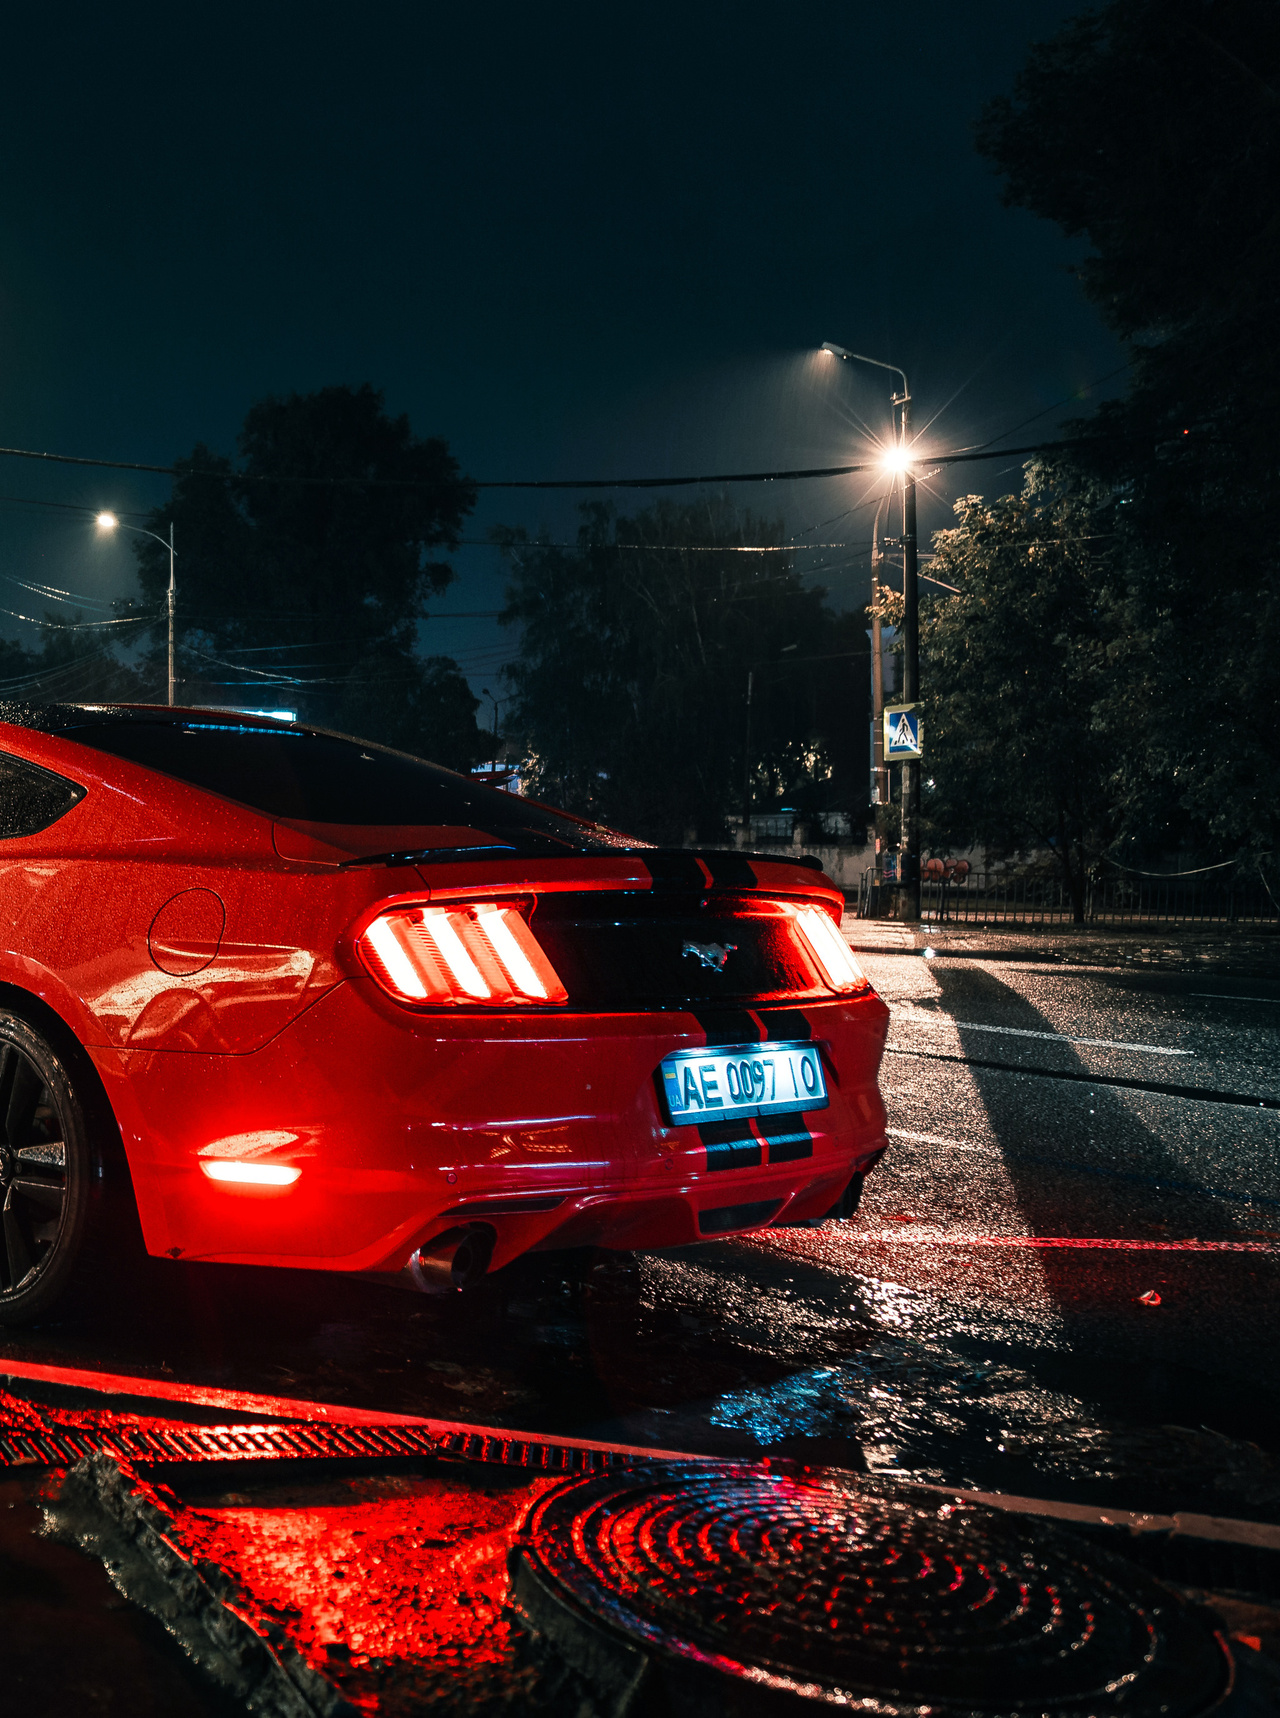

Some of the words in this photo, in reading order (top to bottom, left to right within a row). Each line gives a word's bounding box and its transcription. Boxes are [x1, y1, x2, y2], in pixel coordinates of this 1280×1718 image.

[683, 1063, 724, 1111] AE
[726, 1059, 776, 1103] 0097
[669, 1096, 682, 1107] UA
